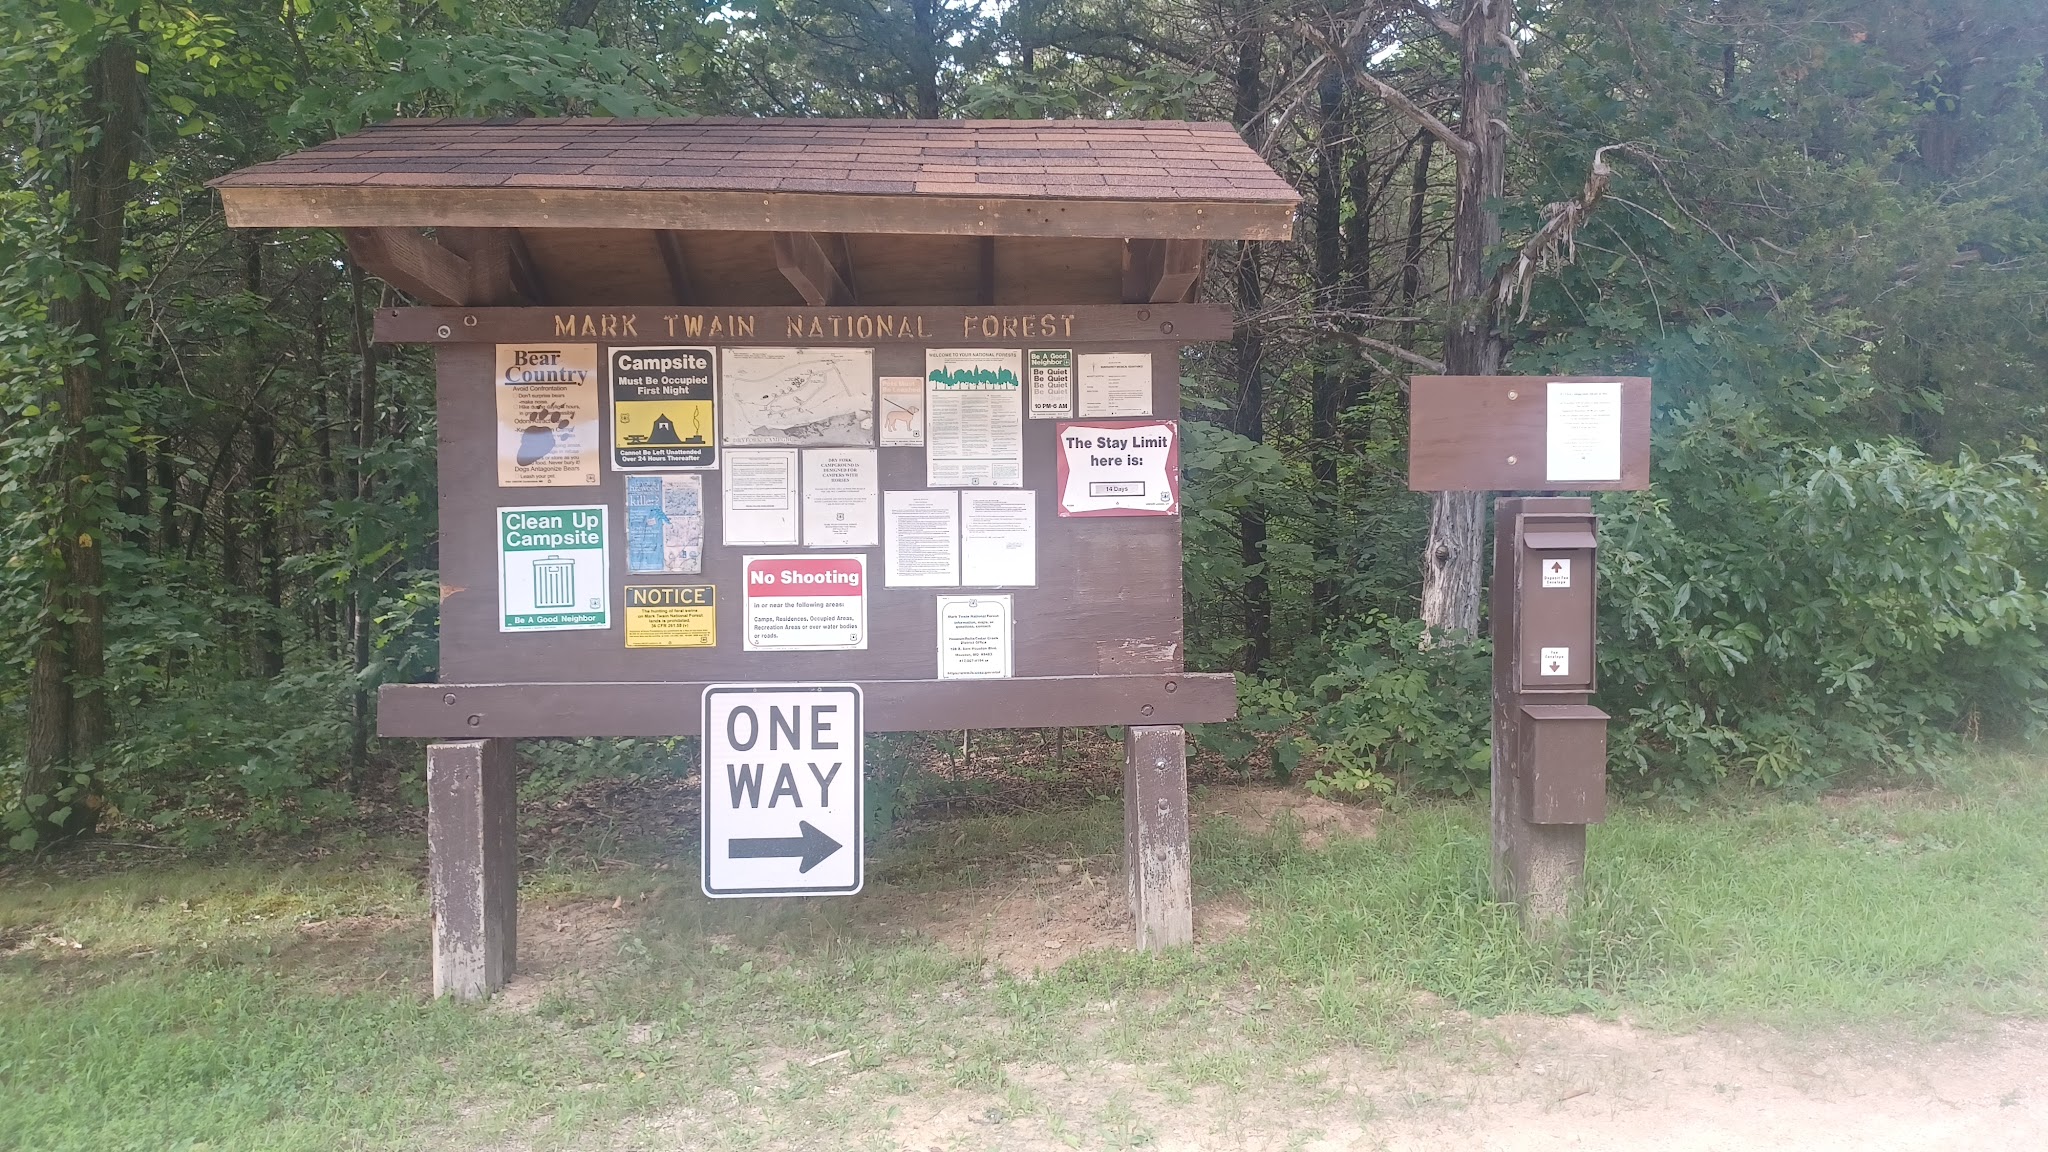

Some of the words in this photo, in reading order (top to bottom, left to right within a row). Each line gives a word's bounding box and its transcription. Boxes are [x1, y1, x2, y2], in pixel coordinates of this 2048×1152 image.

[554, 314, 638, 337] MARK
[664, 314, 755, 337] TWAIN
[786, 314, 932, 339] NATIONAL
[963, 314, 1075, 339] FOREST
[514, 351, 561, 365] Bear
[619, 354, 707, 372] Campsite
[505, 367, 587, 386] Country
[619, 377, 643, 385] Must
[661, 376, 708, 385] Occupied
[637, 387, 660, 395] First
[663, 386, 689, 395] Night
[1066, 437, 1092, 448] The
[1097, 436, 1128, 450] Stay
[1133, 436, 1167, 448] Limit
[1091, 455, 1123, 466] here
[1127, 454, 1143, 466] is:
[506, 514, 562, 530] Clean
[573, 512, 599, 531] Up
[507, 530, 599, 548] Campsite
[751, 570, 775, 585] No
[781, 570, 859, 587] Shooting
[634, 589, 706, 604] NOTICE
[562, 615, 596, 623] Neighbor
[727, 705, 839, 751] ONE
[726, 762, 842, 809] WAY
